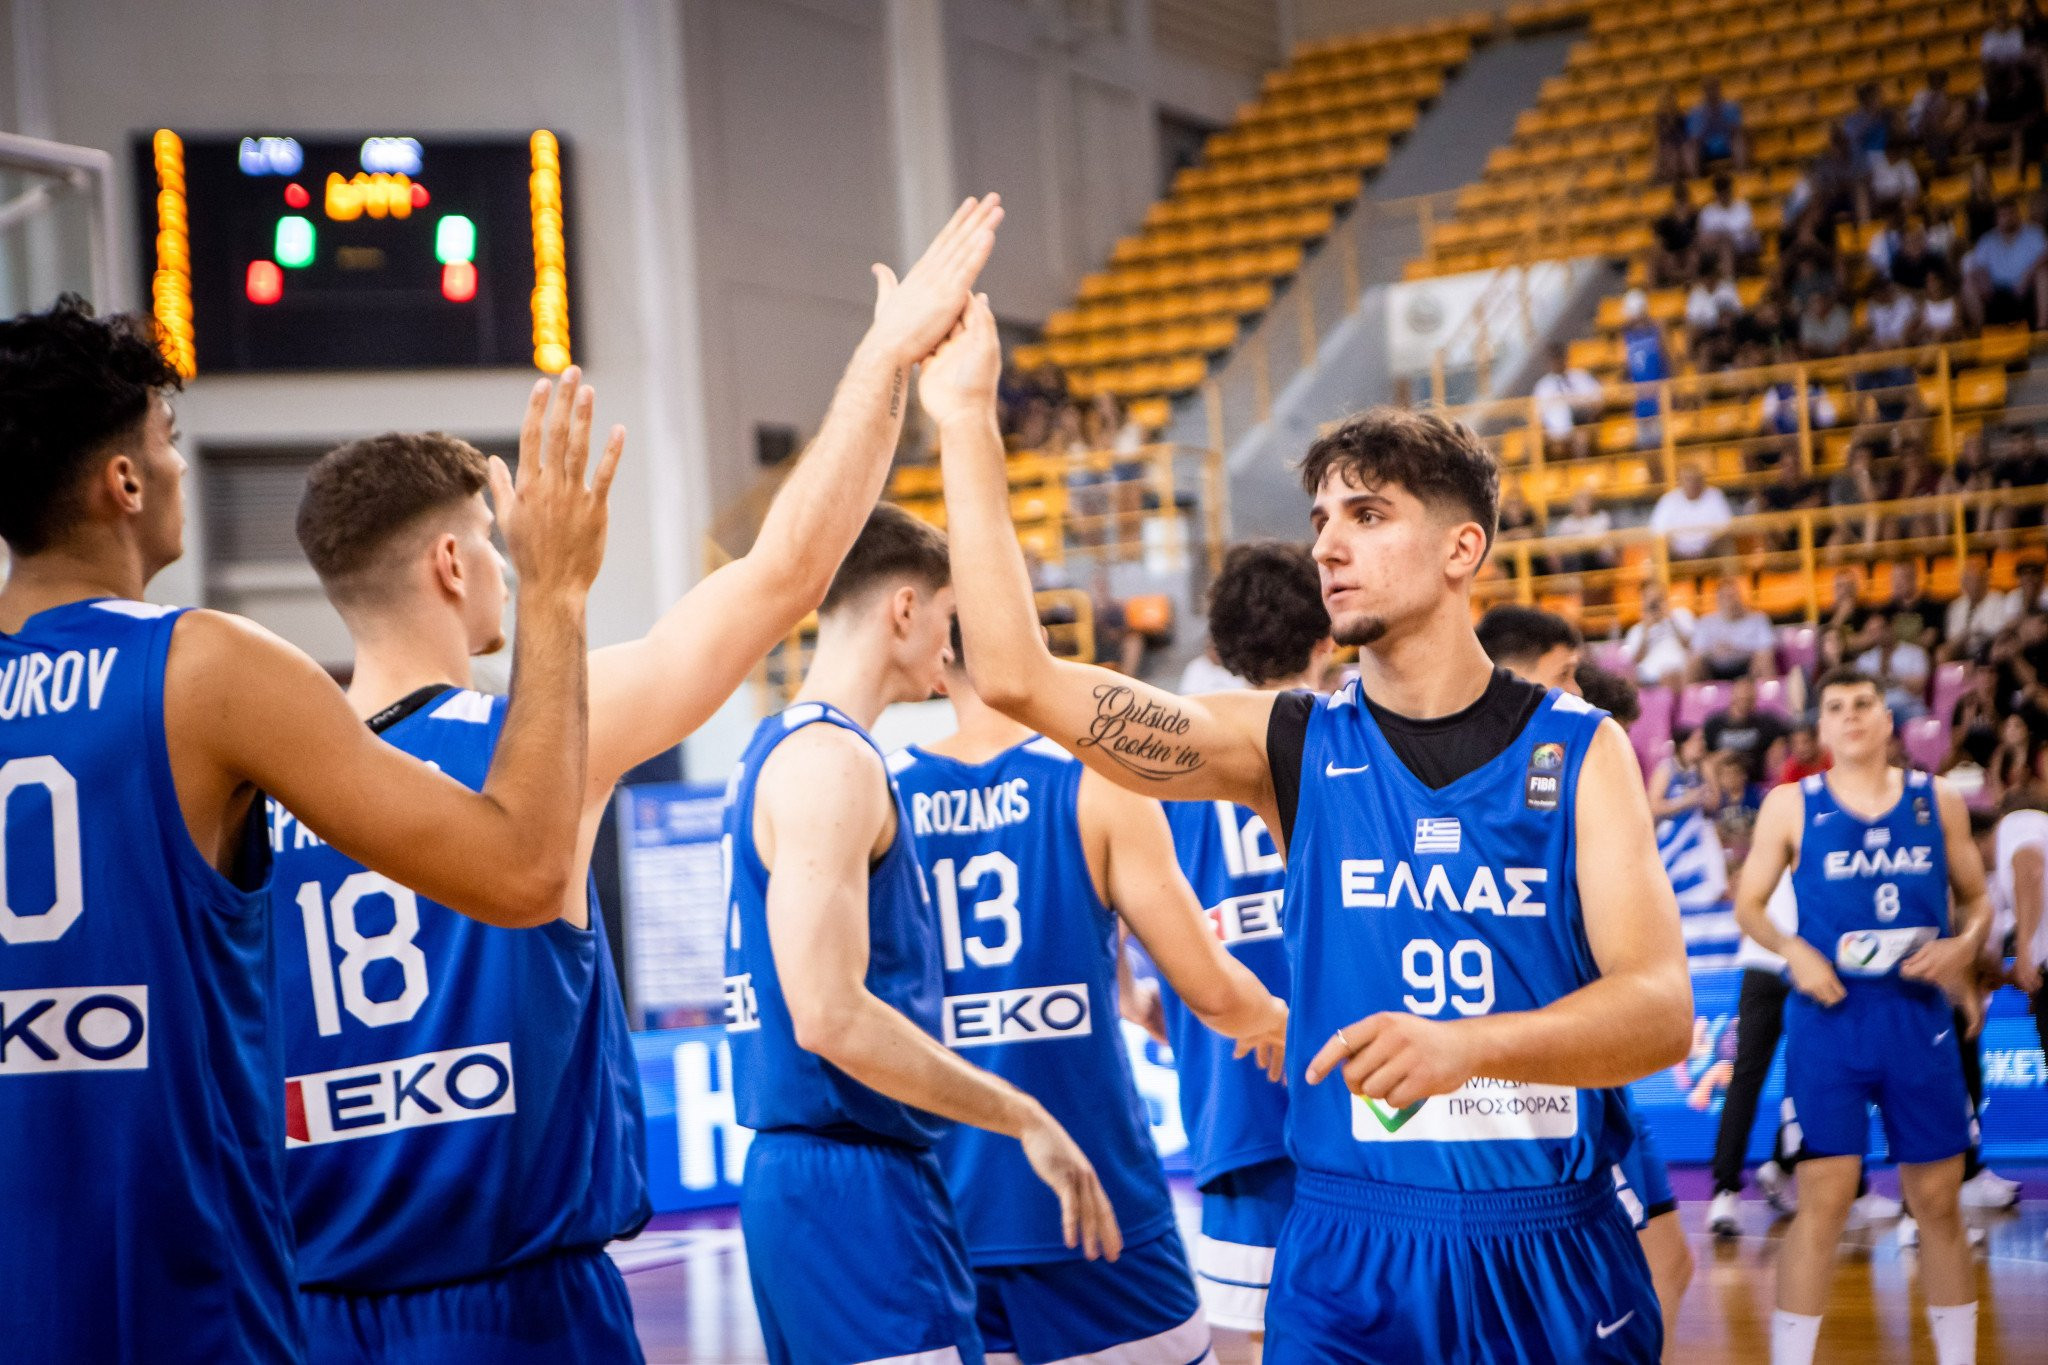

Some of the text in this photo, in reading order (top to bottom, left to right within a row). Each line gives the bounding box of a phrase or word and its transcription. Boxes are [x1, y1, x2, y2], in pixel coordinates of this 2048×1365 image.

[0, 647, 119, 720] UROV
[1093, 684, 1190, 735] Outside
[912, 778, 1030, 836] ROZAKIS
[1530, 777, 1556, 791] FIBA
[1341, 859, 1548, 917] ΕΛΛΑΣ
[1824, 846, 1933, 881] ΕΛΛΑΣ
[932, 851, 1022, 972] 13
[1874, 882, 1900, 923] 8
[295, 870, 430, 1037] 18
[1402, 938, 1496, 1016] 99
[952, 990, 1087, 1039] EKO
[326, 1053, 510, 1131] EKO
[1449, 1095, 1571, 1115] ΠΡΟΣΦΟΡΑΣ
